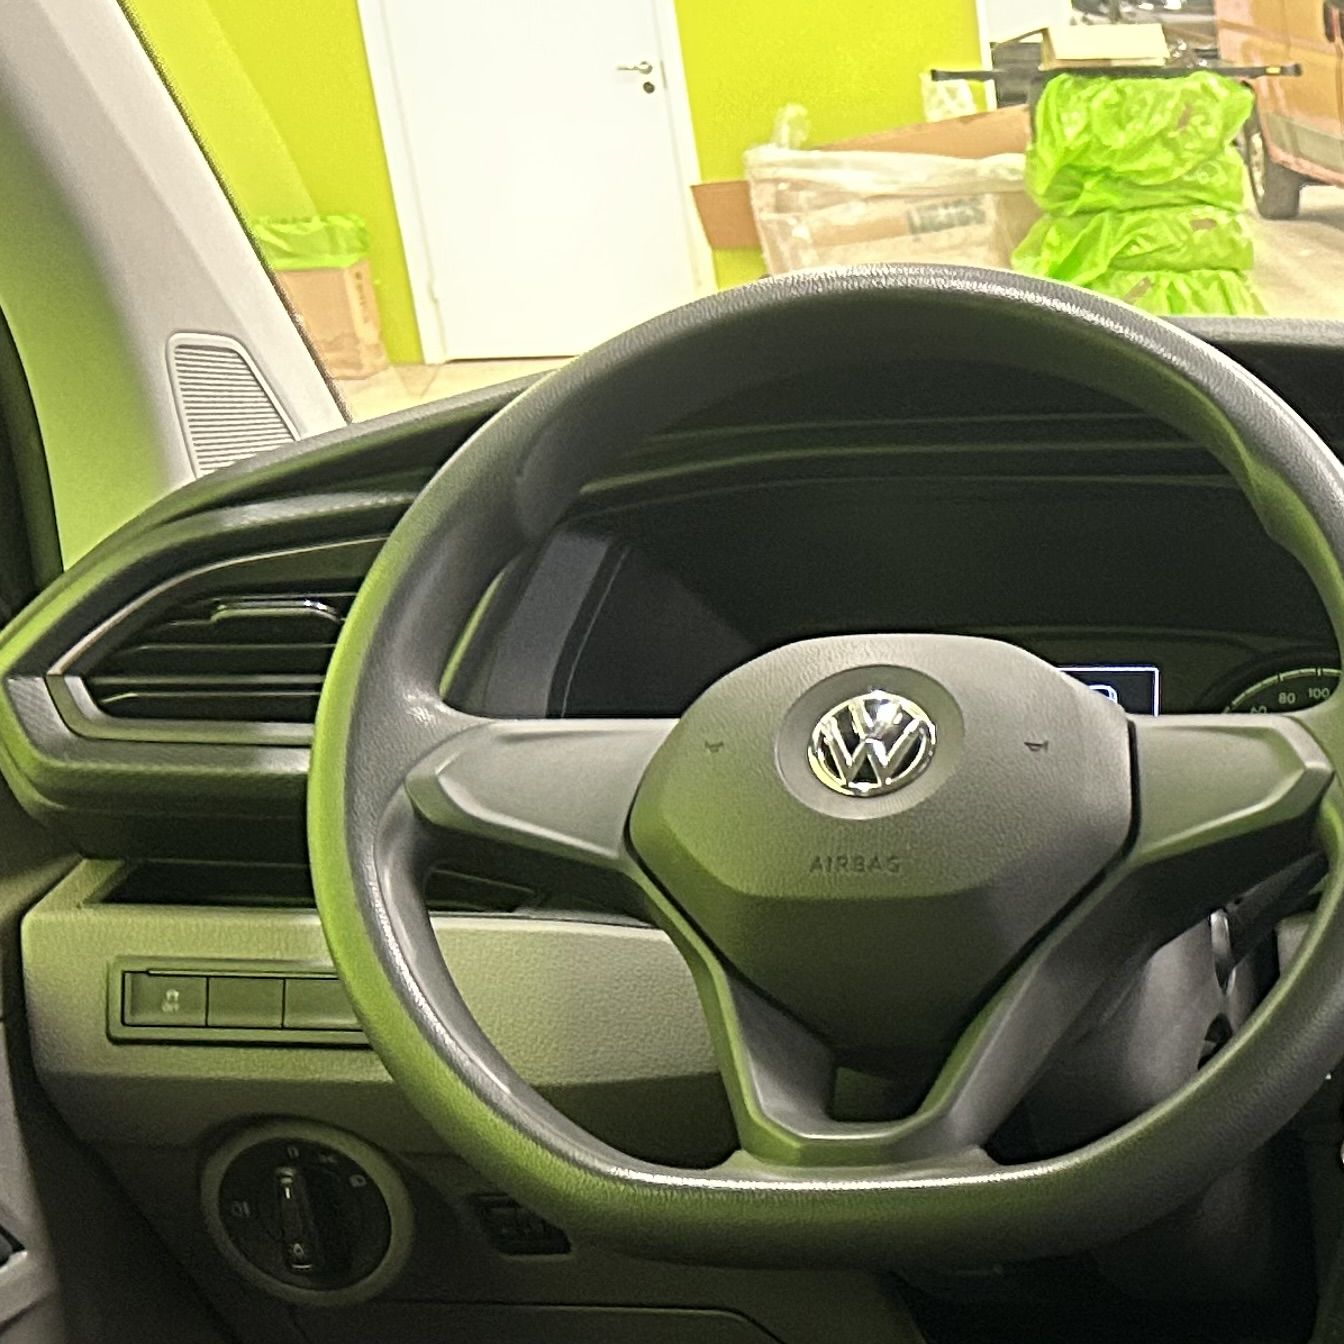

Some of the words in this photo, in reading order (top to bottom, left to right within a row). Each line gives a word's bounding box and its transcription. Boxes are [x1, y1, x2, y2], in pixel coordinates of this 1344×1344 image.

[1278, 692, 1296, 704] 80
[1308, 687, 1330, 699] 100
[809, 855, 900, 873] AIRBAG
